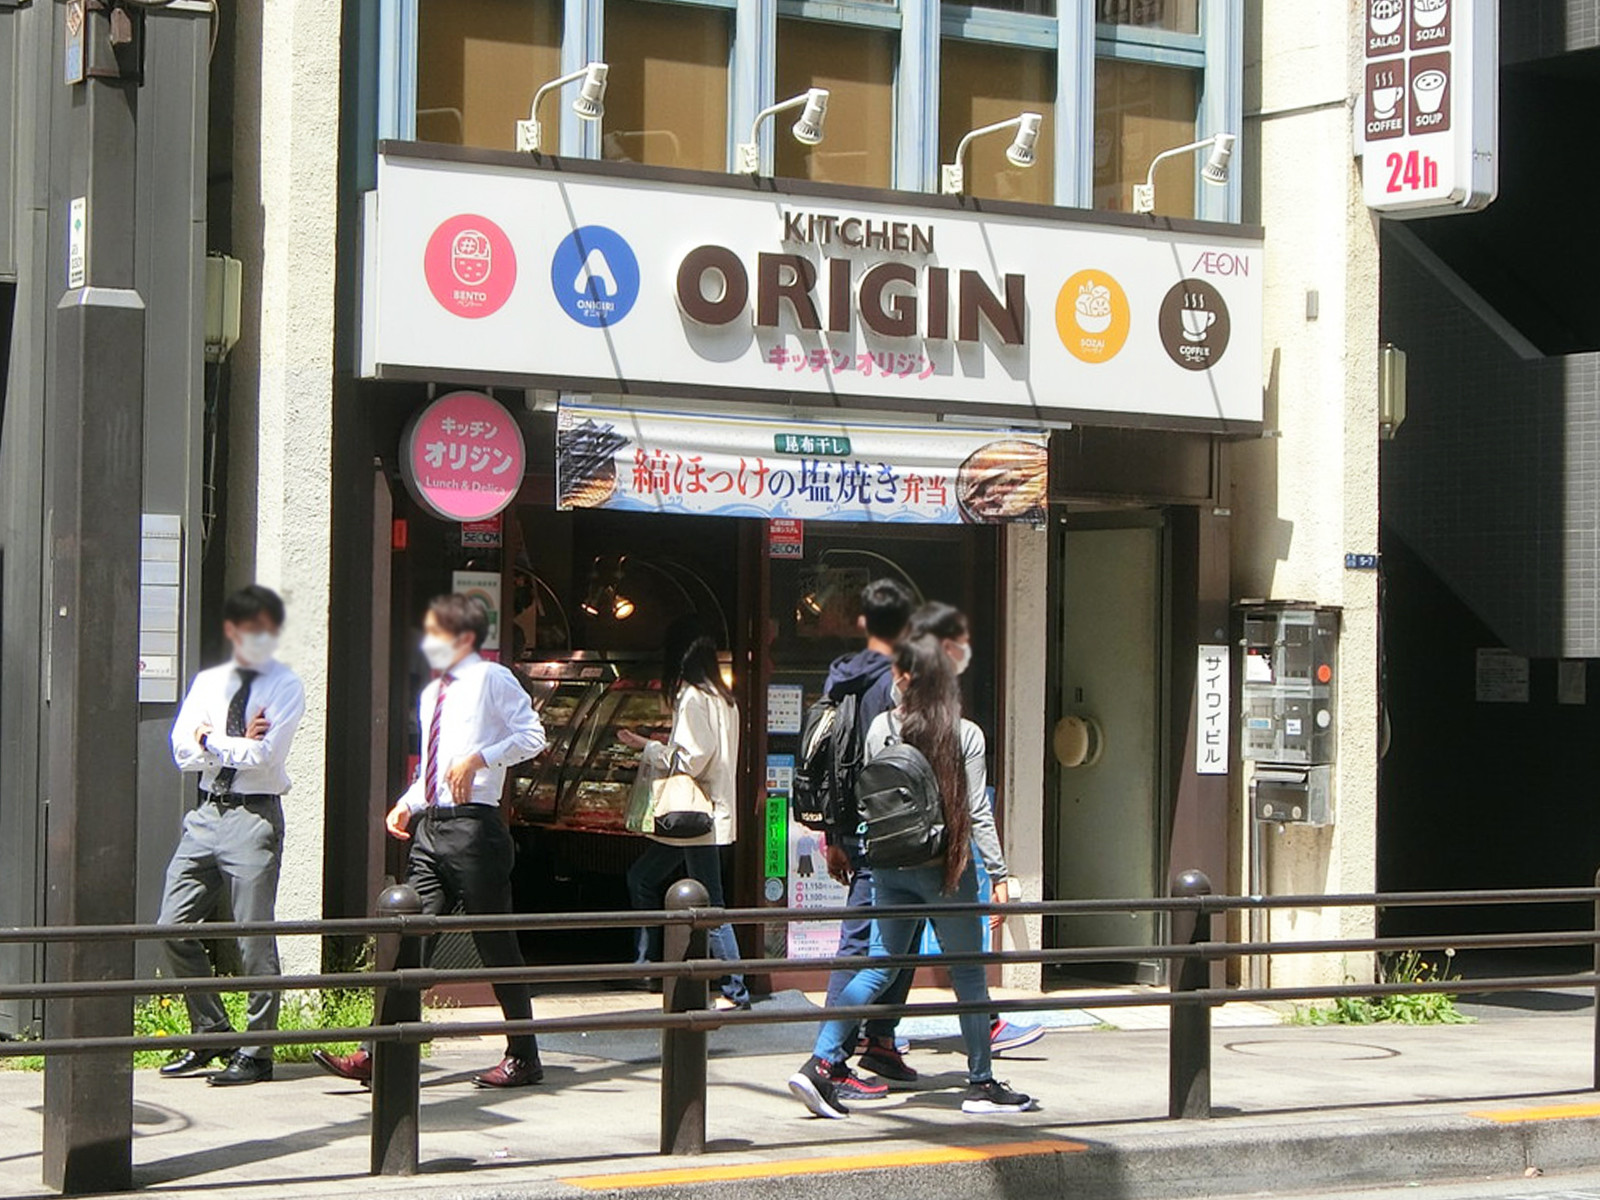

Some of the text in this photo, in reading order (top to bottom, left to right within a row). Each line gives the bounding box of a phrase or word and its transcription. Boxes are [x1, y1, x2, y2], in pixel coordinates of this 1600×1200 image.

[1369, 34, 1401, 50] SALAD
[1415, 26, 1446, 41] SOZAI
[1366, 118, 1403, 133] COFFEE
[1415, 112, 1443, 127] SOUP
[1386, 150, 1438, 194] 24h
[783, 211, 935, 254] KITCHEN
[453, 290, 488, 302] BENTO
[675, 244, 1026, 345] ORIGIN
[576, 299, 615, 311] ONIGIRI
[1080, 338, 1105, 348] SOZAI
[1179, 345, 1211, 356] COFFEE
[769, 345, 936, 381] キッチン オリジン
[441, 416, 499, 440] キッチン
[784, 436, 844, 455] 昆布干し
[424, 441, 514, 475] オリジン
[425, 475, 506, 496] Lunch & Delica
[632, 447, 948, 507] 縞ほっけの塩焼き弁当
[463, 532, 501, 543] SECOM
[1204, 656, 1222, 764] サイワイビル
